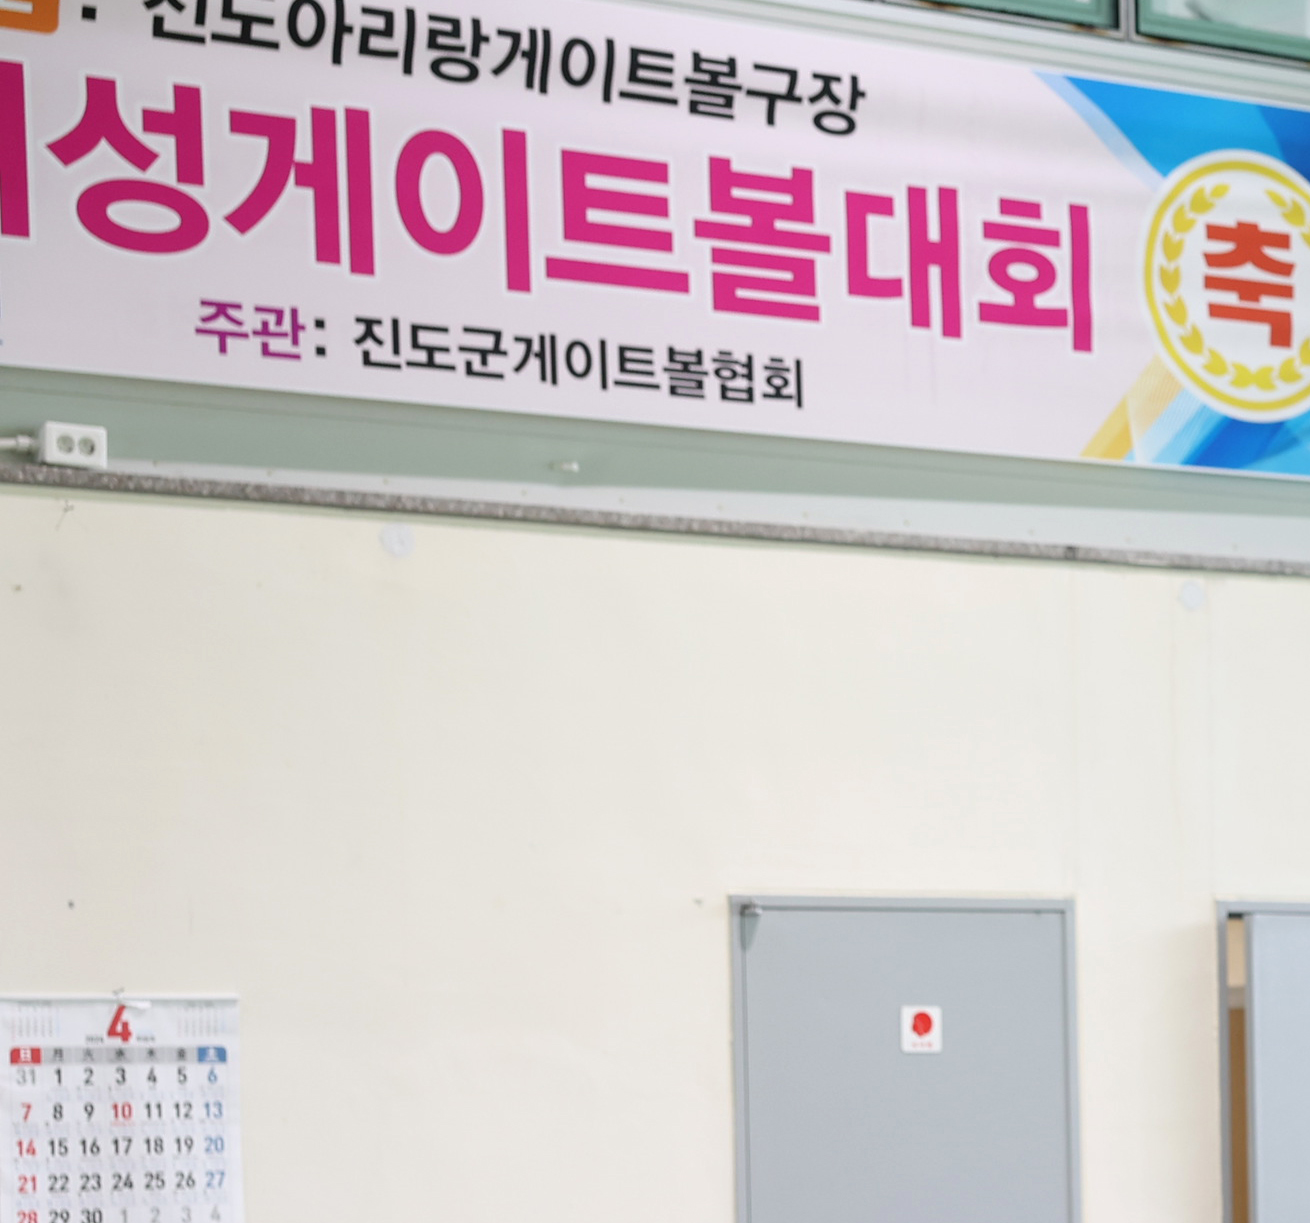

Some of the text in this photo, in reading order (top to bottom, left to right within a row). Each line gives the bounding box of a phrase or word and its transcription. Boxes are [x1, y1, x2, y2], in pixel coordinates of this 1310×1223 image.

[0, 60, 1093, 352] 성게이트볼대회
[1203, 220, 1295, 348] 축
[353, 315, 803, 408] 진도군게이트볼협회
[107, 1003, 132, 1042] 4
[16, 1066, 218, 1085] 31 1 2 3 4 5 6
[21, 1102, 223, 1121] 7 8 9 10 11 12 13
[17, 1138, 225, 1157] 14 15 16 17 18 19 20
[18, 1172, 226, 1193] 21 22 23 24 25 26 27
